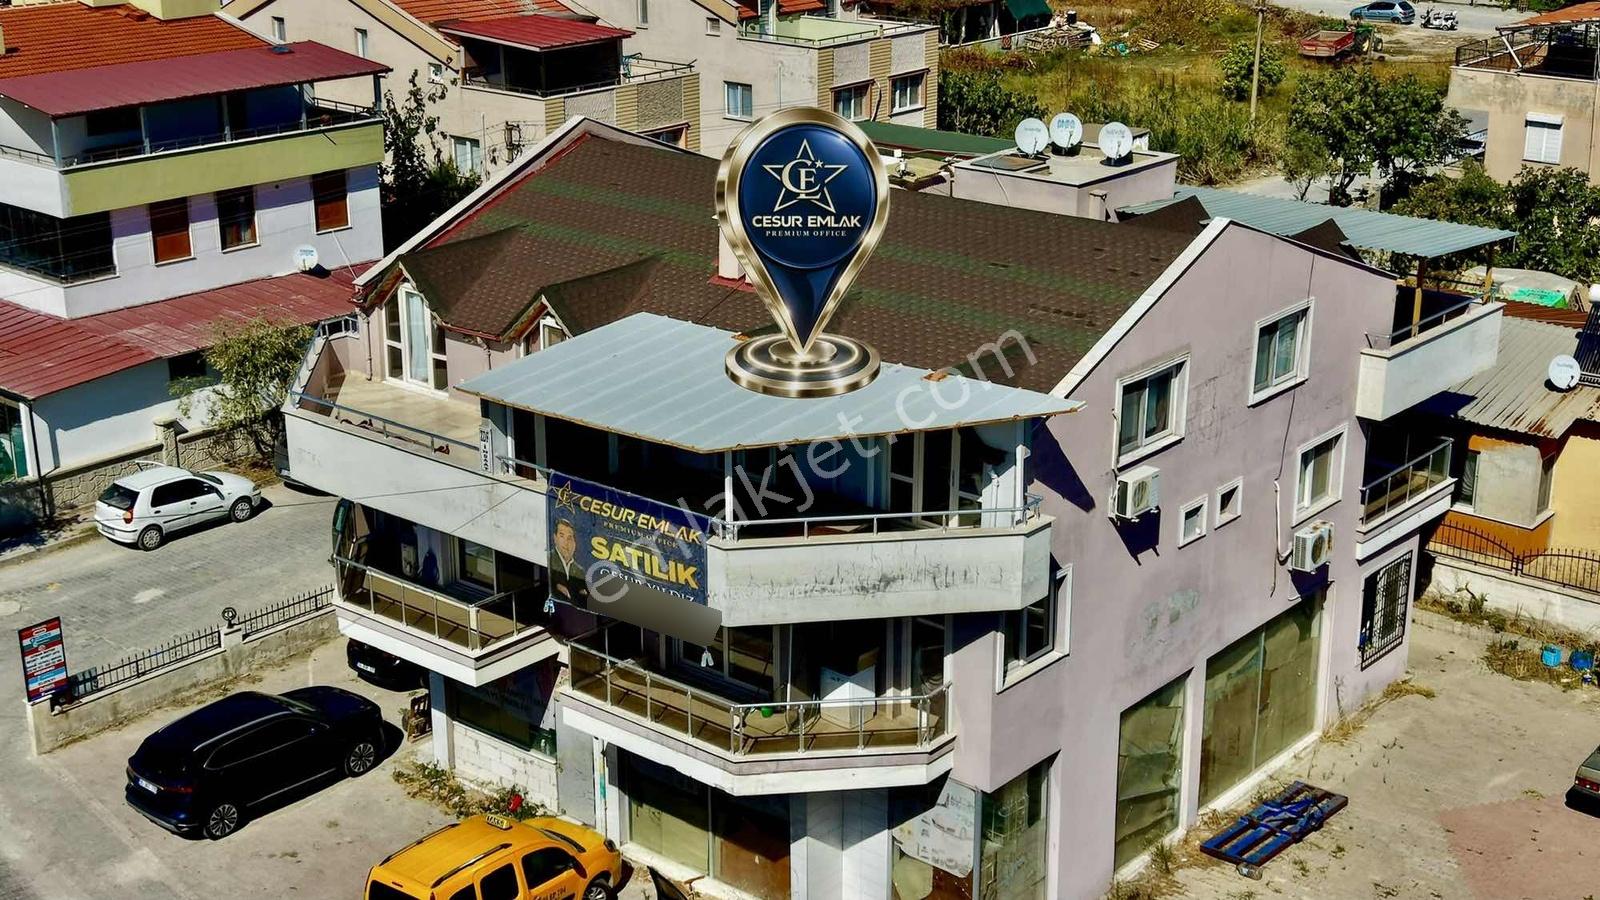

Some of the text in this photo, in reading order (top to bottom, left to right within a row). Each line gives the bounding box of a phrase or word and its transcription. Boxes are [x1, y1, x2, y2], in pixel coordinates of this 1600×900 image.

[580, 496, 702, 545] CESUR EMLAK
[590, 536, 699, 590] SATILIK
